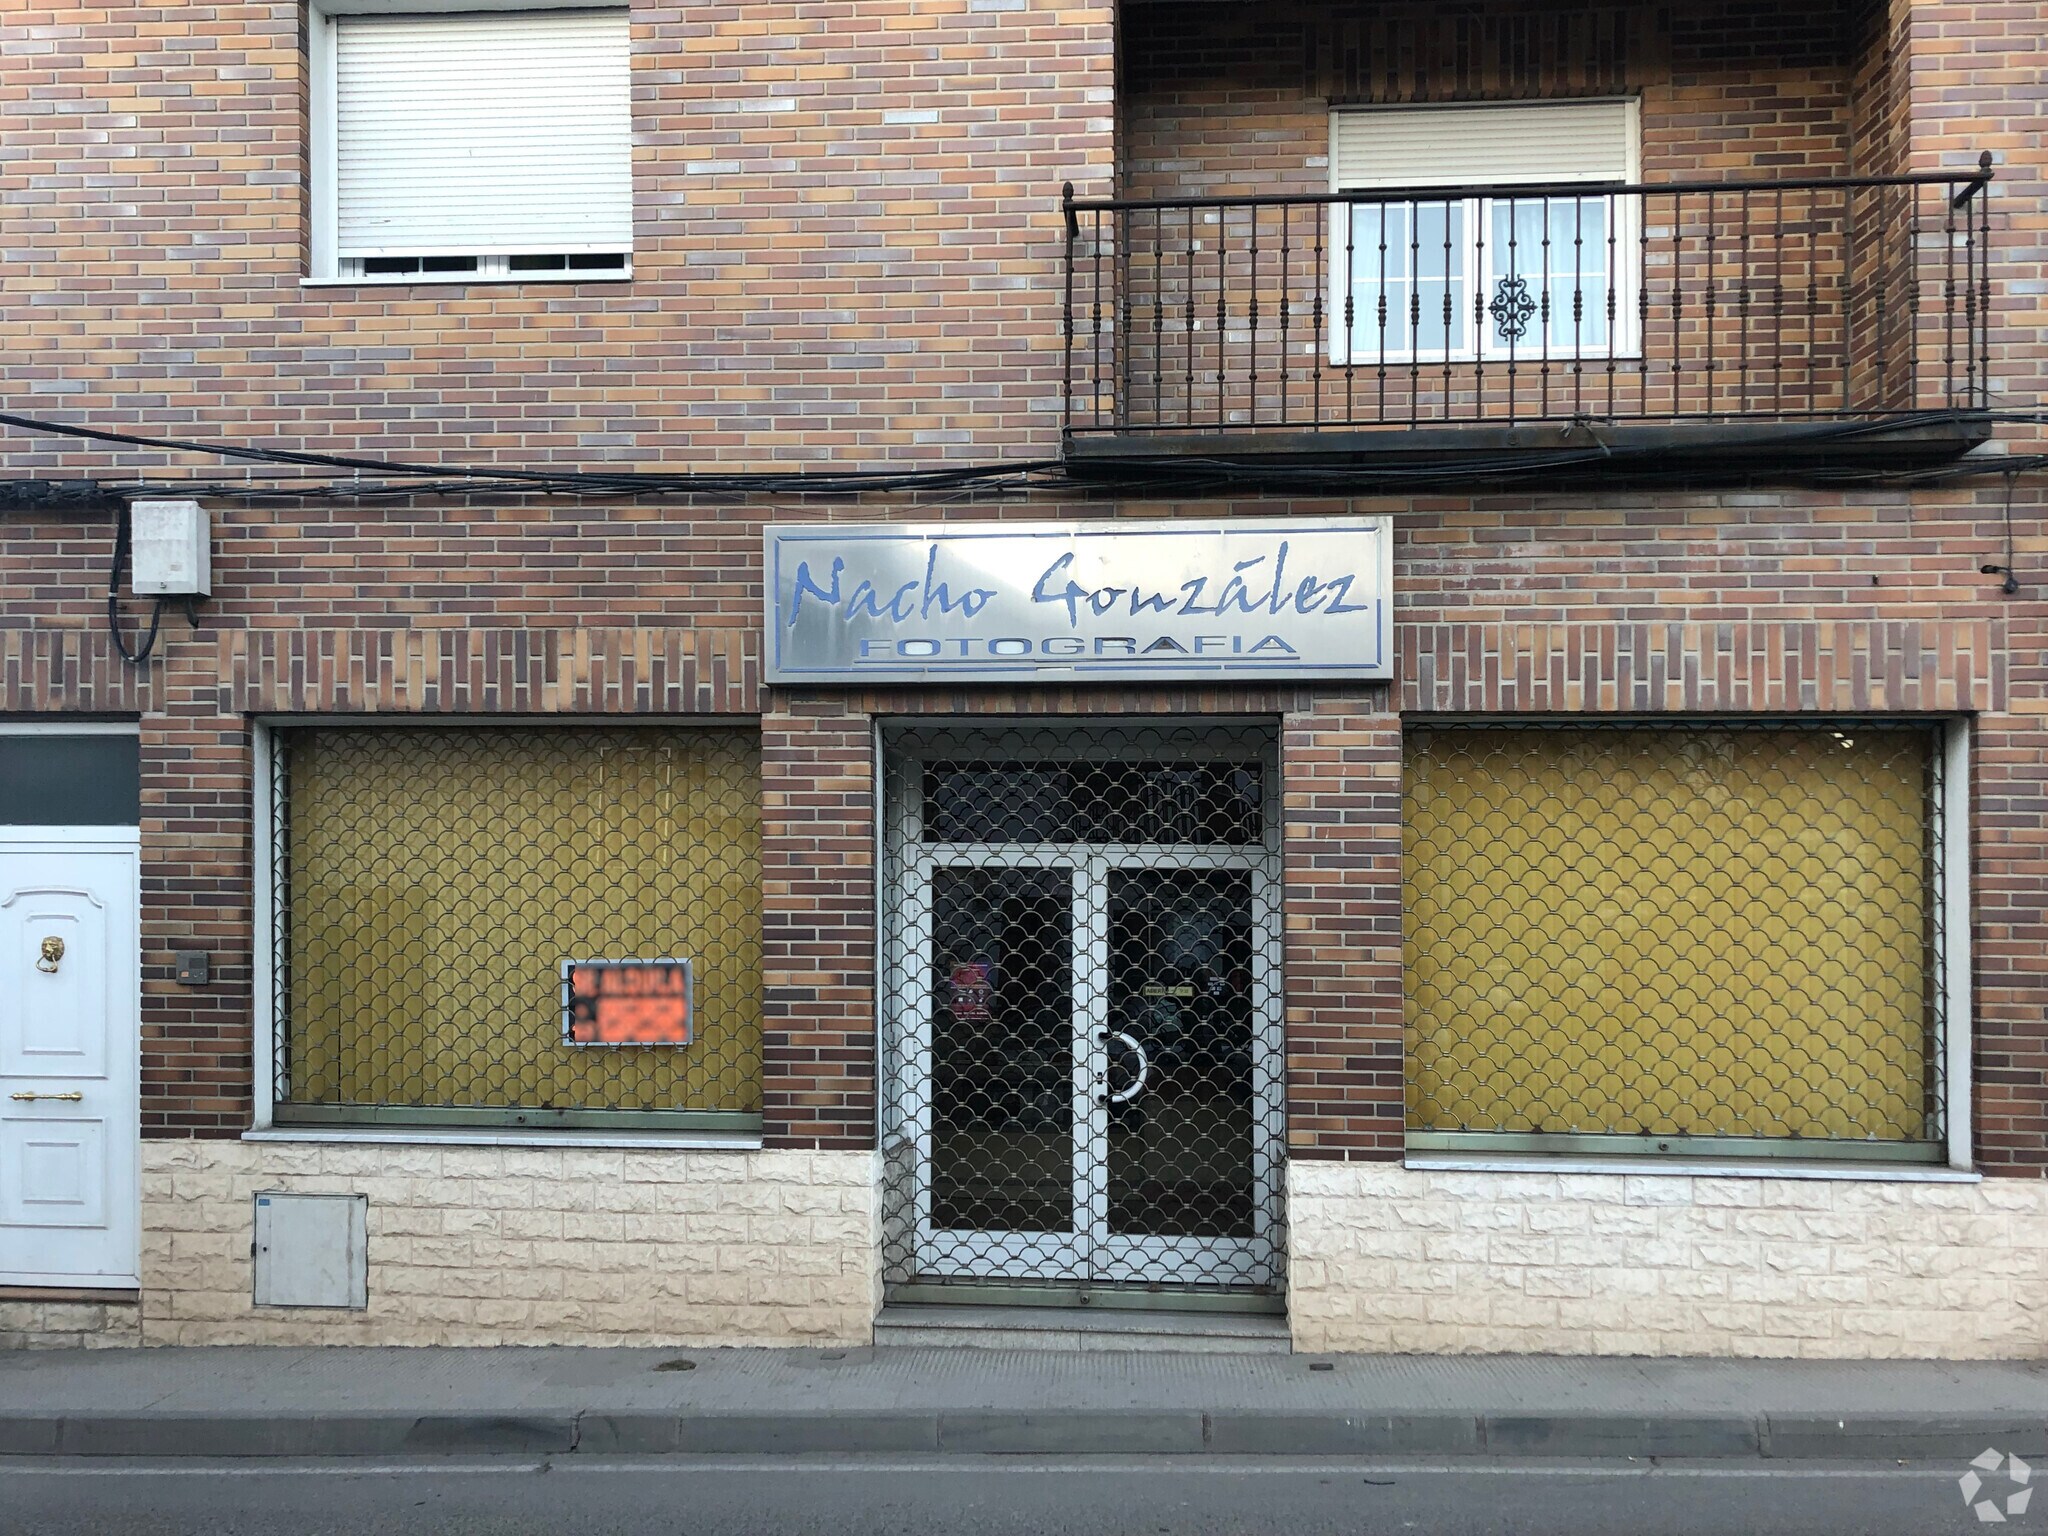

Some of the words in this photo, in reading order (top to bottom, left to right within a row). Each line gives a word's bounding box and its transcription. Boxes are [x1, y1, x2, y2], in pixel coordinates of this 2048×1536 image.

[787, 543, 998, 627] Nacho
[1031, 541, 1368, 628] González
[860, 635, 1297, 657] FOTOGRAFIA
